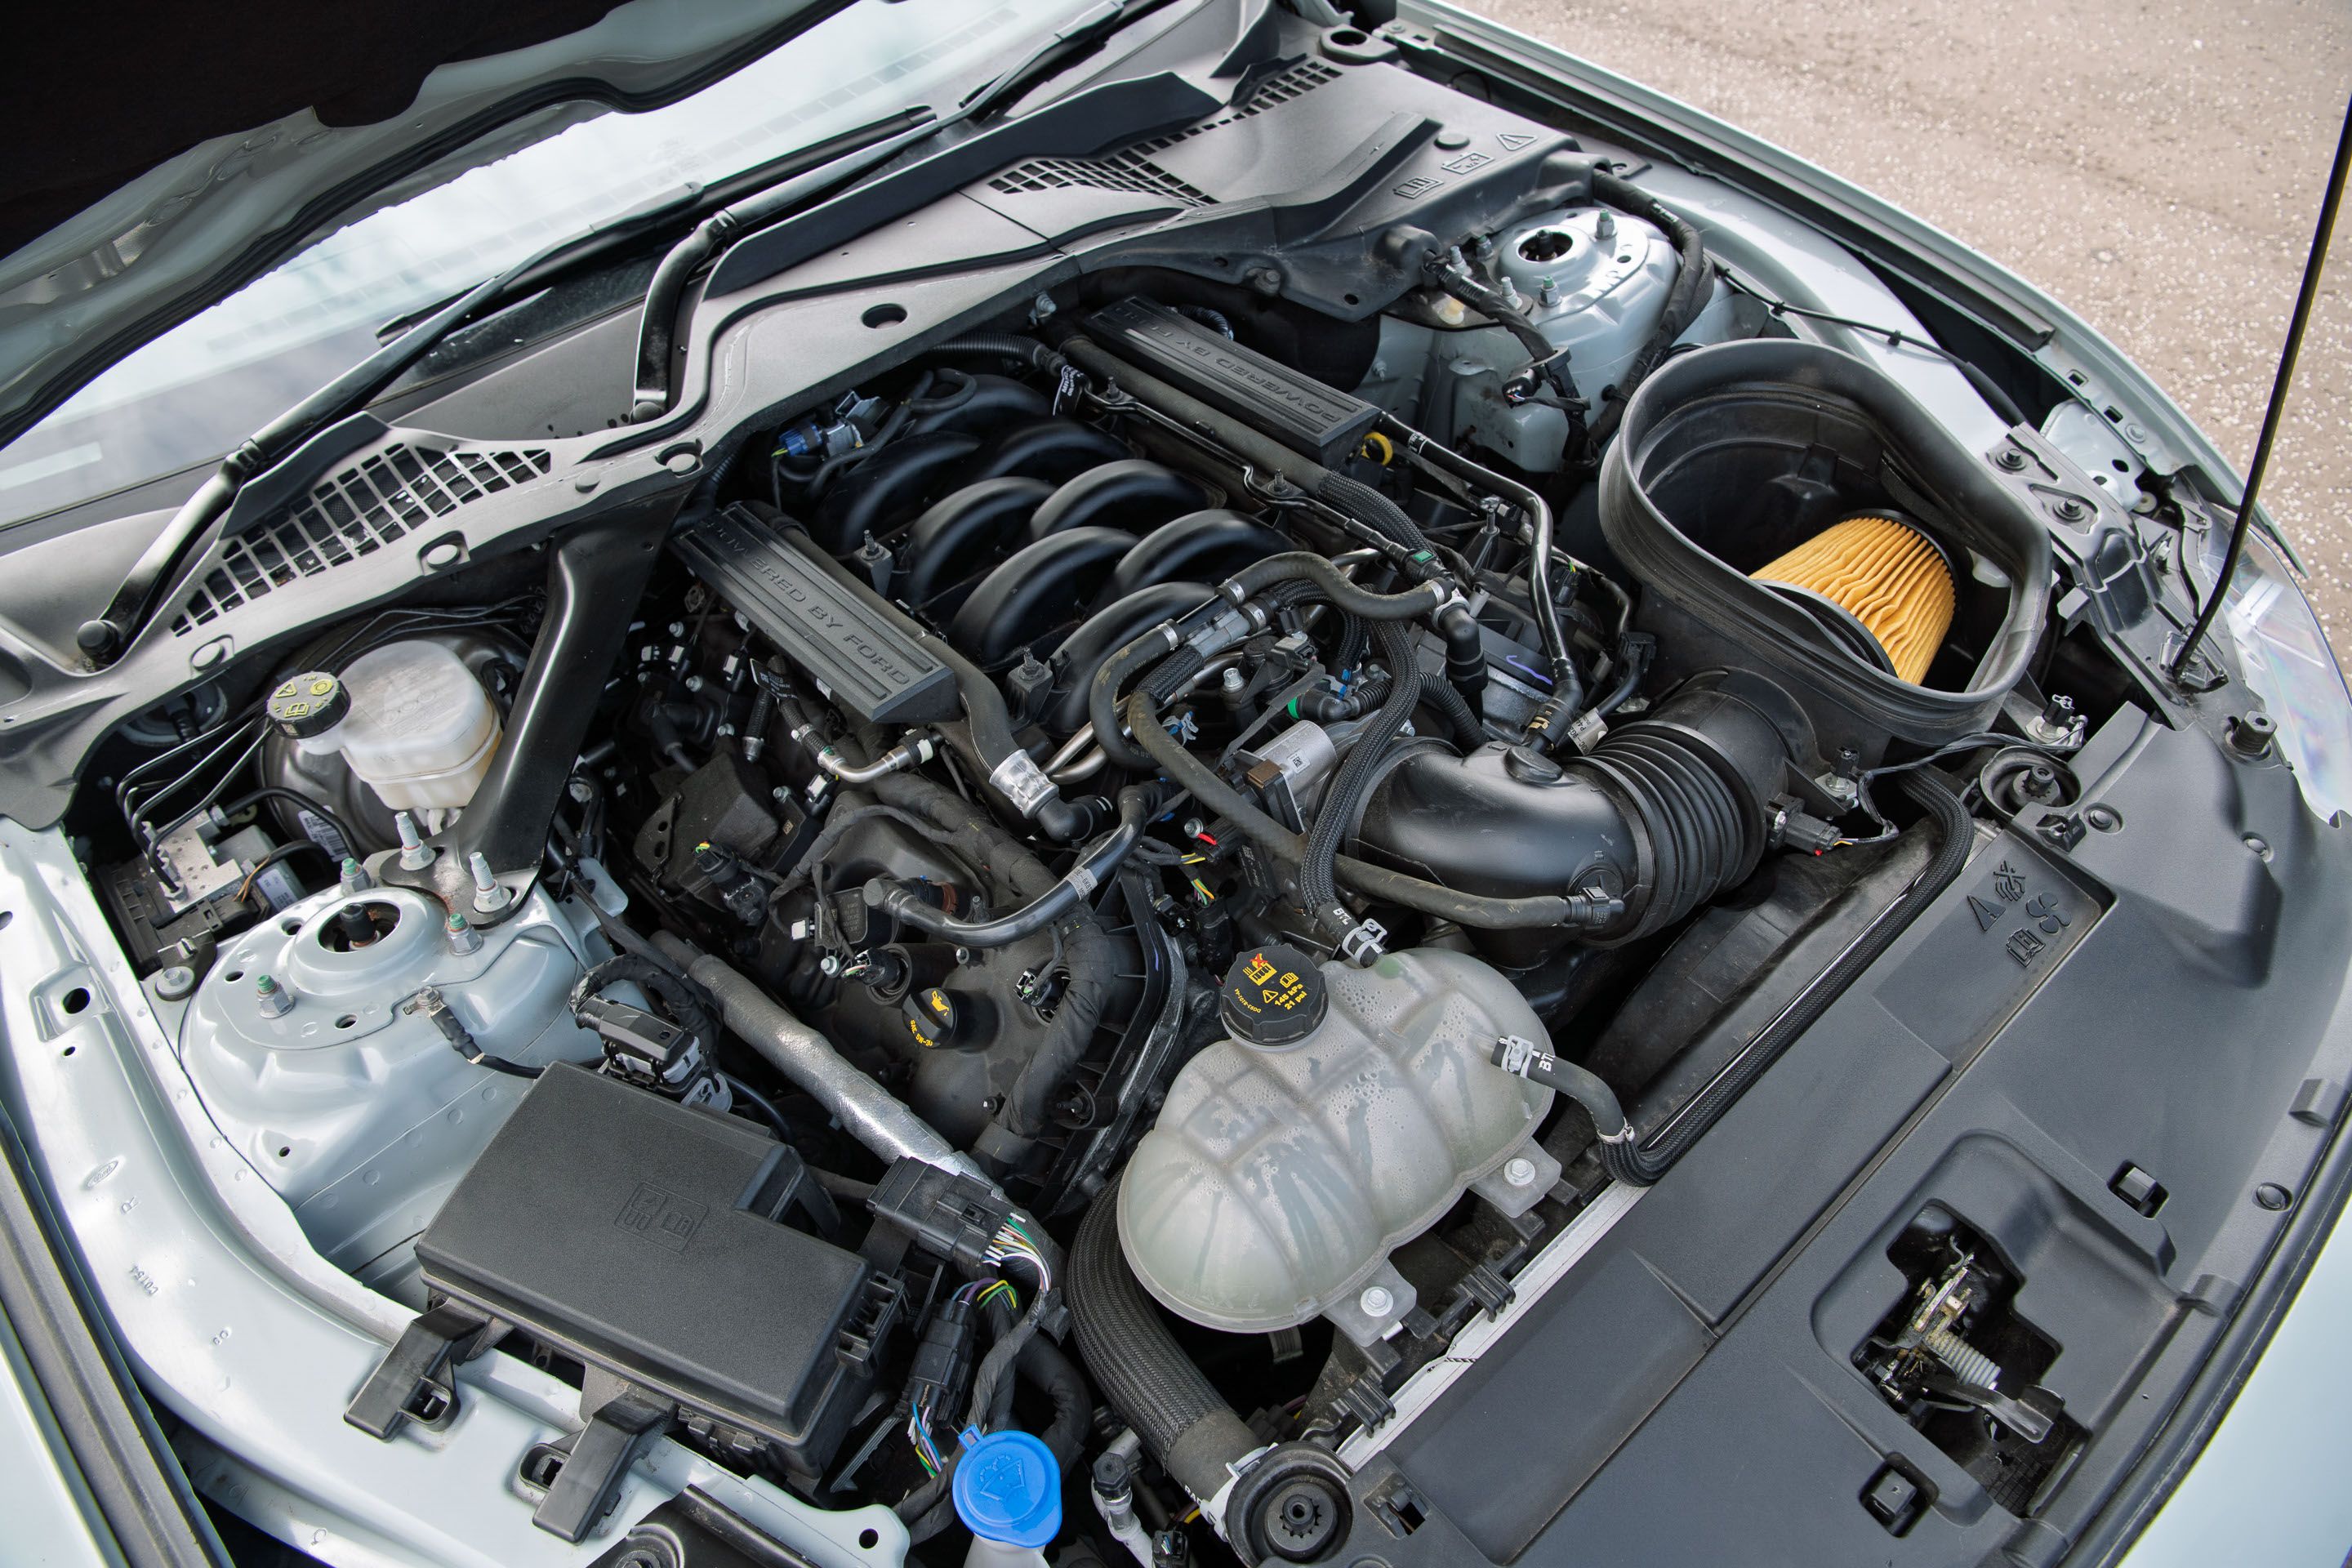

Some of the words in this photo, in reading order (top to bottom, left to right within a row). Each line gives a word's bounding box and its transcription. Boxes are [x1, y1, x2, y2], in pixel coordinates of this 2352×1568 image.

[1175, 341, 1210, 357] BY
[1215, 358, 1342, 423] POWERED
[807, 605, 843, 629] BY
[843, 633, 911, 685] FORD
[1333, 907, 1352, 925] BTL
[1274, 993, 1290, 1006] 145
[1287, 983, 1304, 996] kPa
[1284, 1000, 1296, 1010] 21
[1294, 991, 1307, 1003] psi
[910, 1019, 918, 1034] SAE
